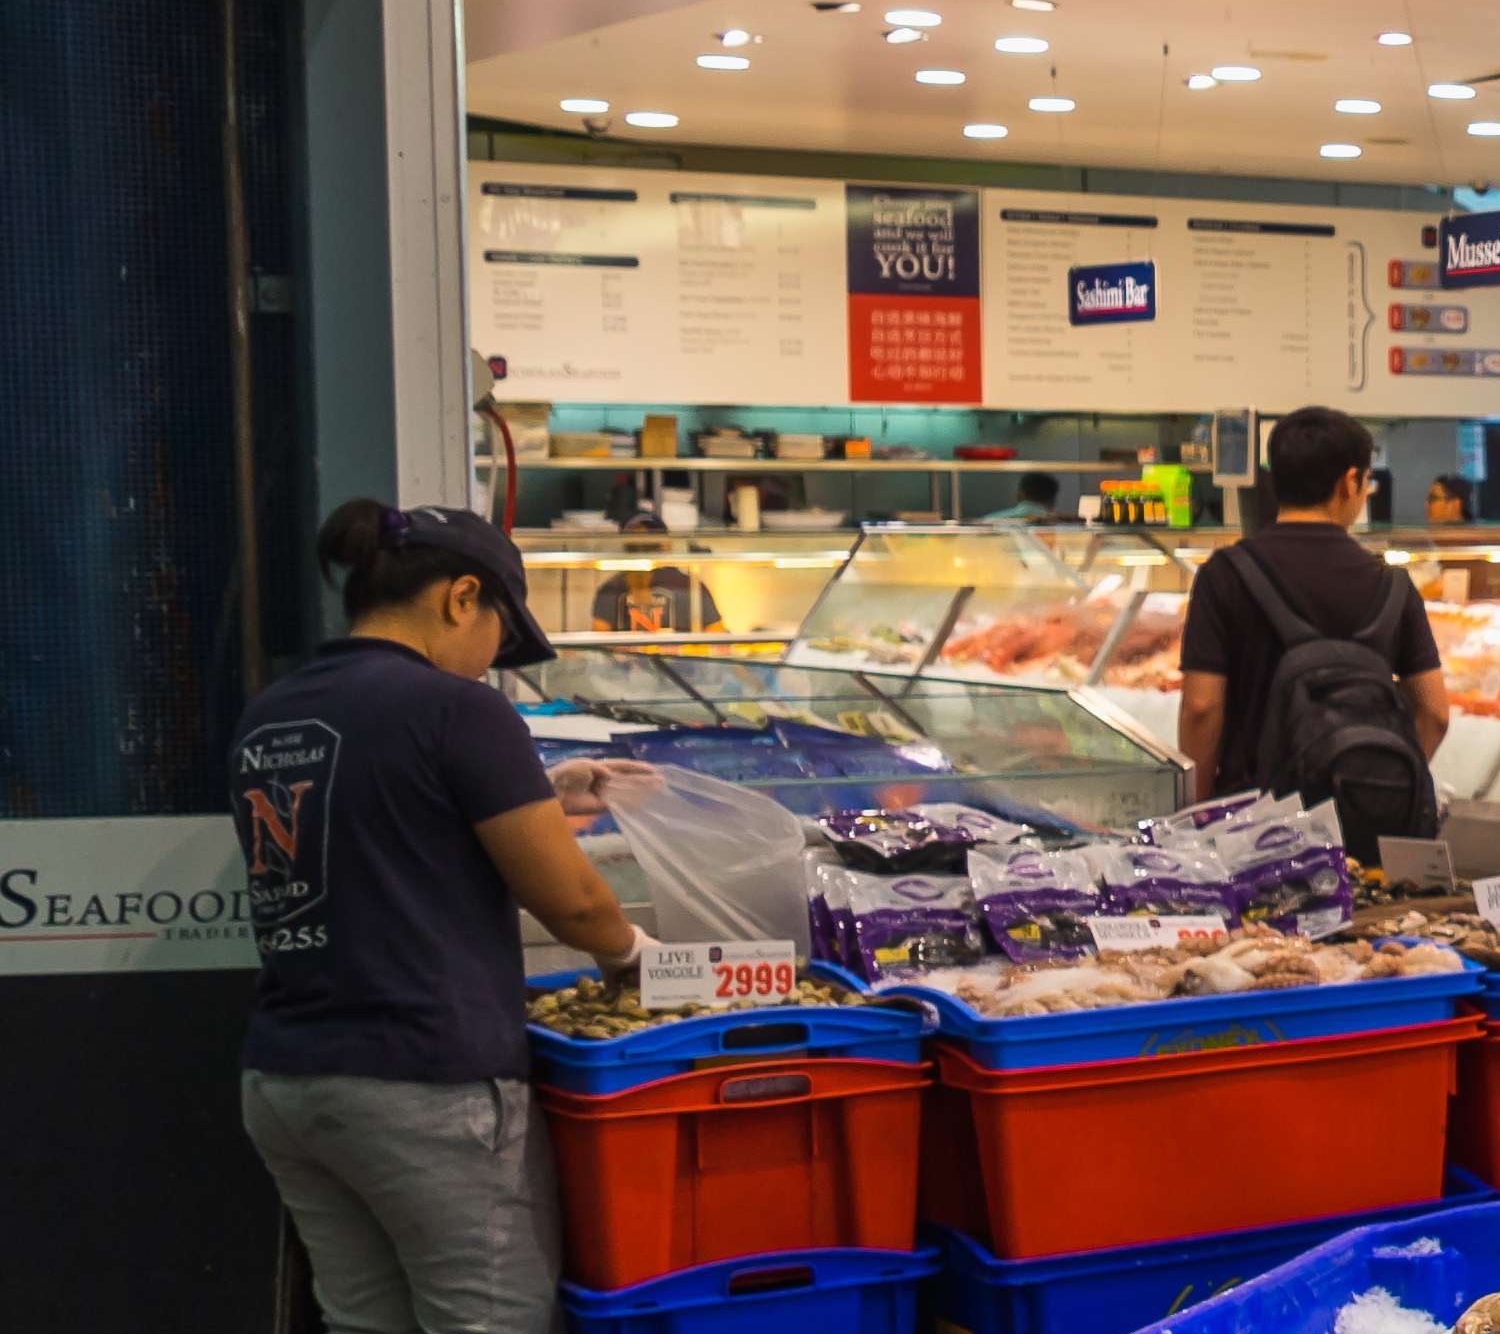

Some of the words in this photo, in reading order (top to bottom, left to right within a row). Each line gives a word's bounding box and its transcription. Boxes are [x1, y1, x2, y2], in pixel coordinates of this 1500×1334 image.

[875, 253, 955, 281] YOU!
[1077, 279, 1123, 311] Sashimi
[1125, 276, 1149, 306] Bar
[240, 745, 326, 772] NICHOLAS
[244, 780, 313, 875] N
[658, 951, 694, 964] LIVE
